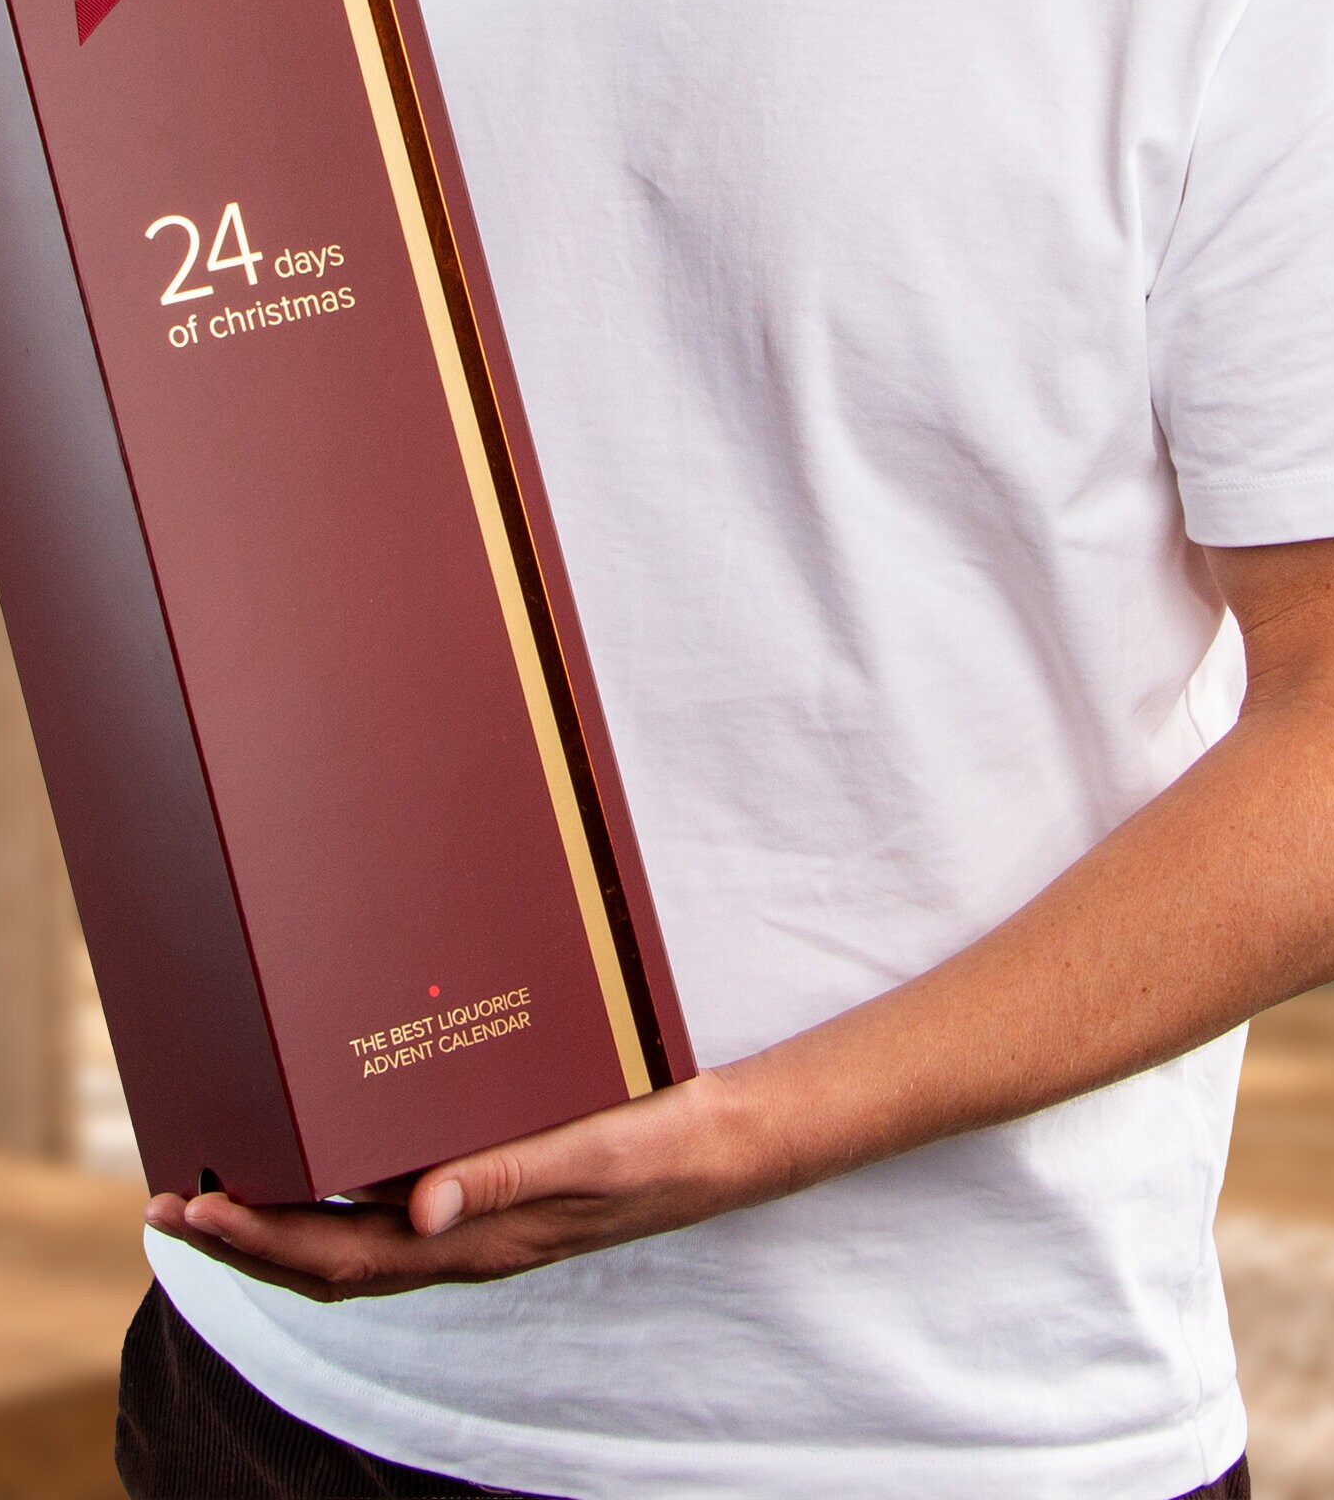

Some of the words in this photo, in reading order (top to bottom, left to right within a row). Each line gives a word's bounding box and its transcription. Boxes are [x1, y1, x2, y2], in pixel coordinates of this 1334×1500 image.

[144, 201, 264, 306] 24
[273, 243, 346, 278] days
[168, 313, 199, 348] of
[208, 286, 356, 339] christmas
[348, 1031, 389, 1057] THE
[389, 1016, 434, 1046] BEST
[437, 986, 532, 1031] LIQUORICE
[363, 1040, 434, 1078] ADVENT
[438, 1010, 532, 1054] CALENDAR
